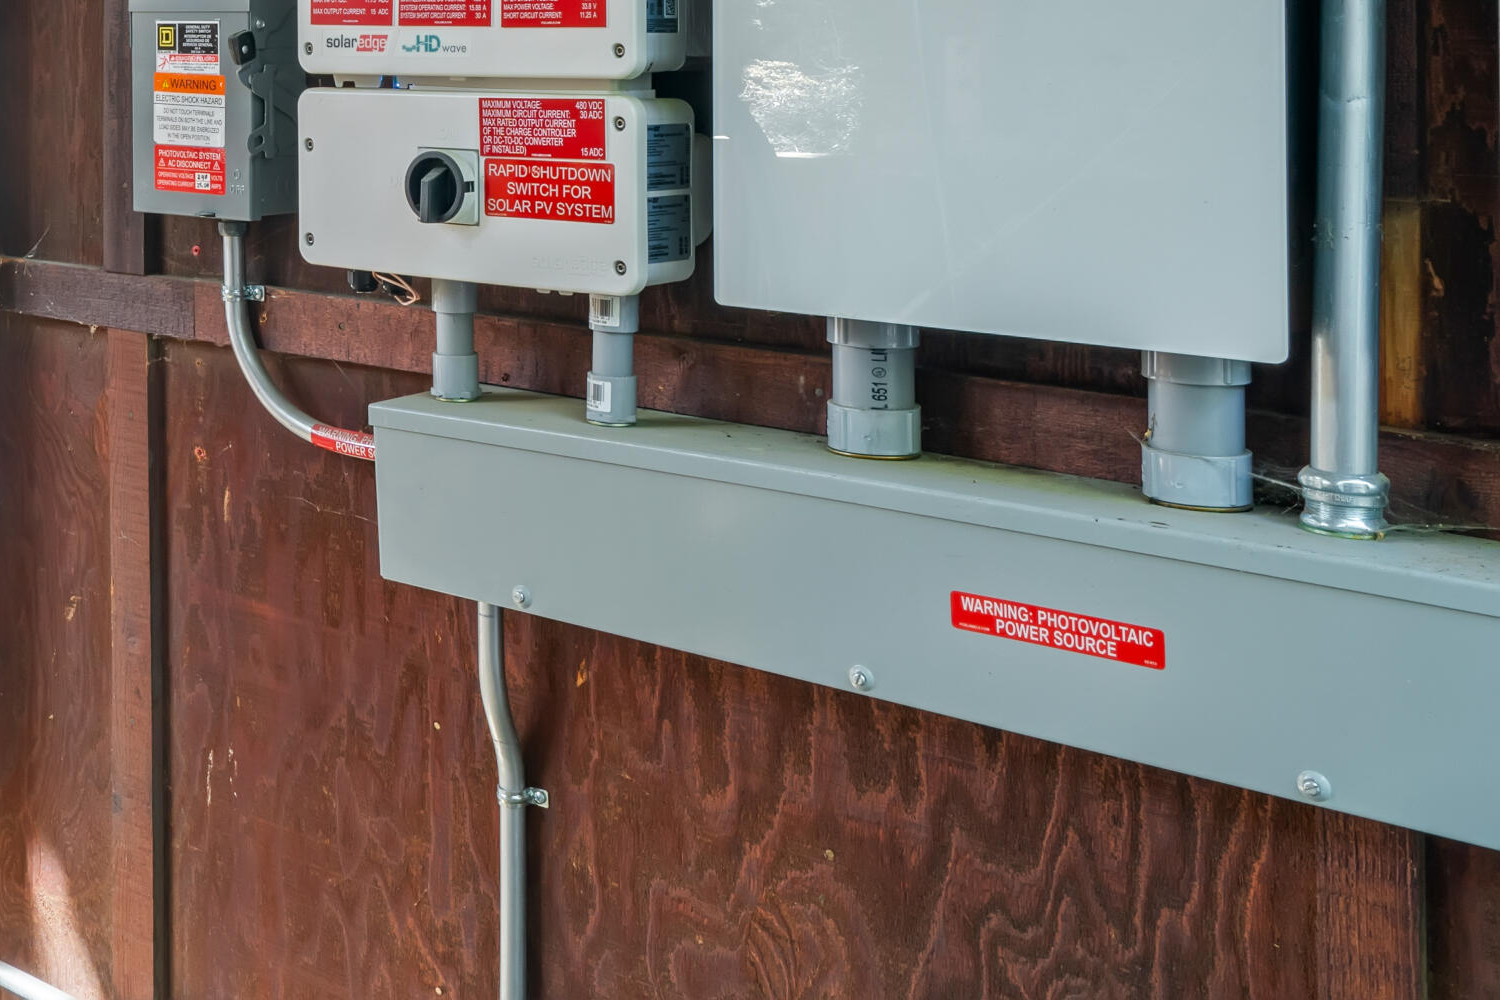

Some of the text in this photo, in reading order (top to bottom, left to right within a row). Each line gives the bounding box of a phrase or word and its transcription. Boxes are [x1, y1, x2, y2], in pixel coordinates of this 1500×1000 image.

[416, 35, 467, 53] HD wave
[171, 79, 216, 90] WARNING
[201, 97, 222, 105] HAZARD
[482, 101, 511, 109] MAXIMUM
[512, 101, 542, 109] VOLTAGE:
[588, 101, 602, 110] VDC
[482, 109, 603, 119] MAXIMUM CIRCUIT CURRENT: 30 ADC
[482, 118, 576, 128] MAX RATED OUTPUT CURRENT
[483, 127, 577, 137] OF THE CHARGE CONTROLLER
[483, 136, 564, 146] OR DC-TO-DC CONVERTER
[158, 149, 220, 160] PHOTOVOLTAIC SYSTEM
[483, 145, 491, 154] (IF
[492, 145, 527, 155] INSTALLED)
[581, 148, 588, 156] 15
[589, 148, 604, 157] ADC
[177, 160, 211, 169] DISCONNECT
[488, 163, 611, 182] RAPID SHUTDOWN
[507, 182, 591, 199] SWITCH FOR
[488, 198, 613, 219] SOLAR PV SYSTEM
[871, 382, 887, 401] 651
[336, 442, 366, 456] POWER
[961, 596, 1154, 648] WARNING: PHOTOVOLTAIC
[996, 619, 1117, 657] POWER SOURCE
